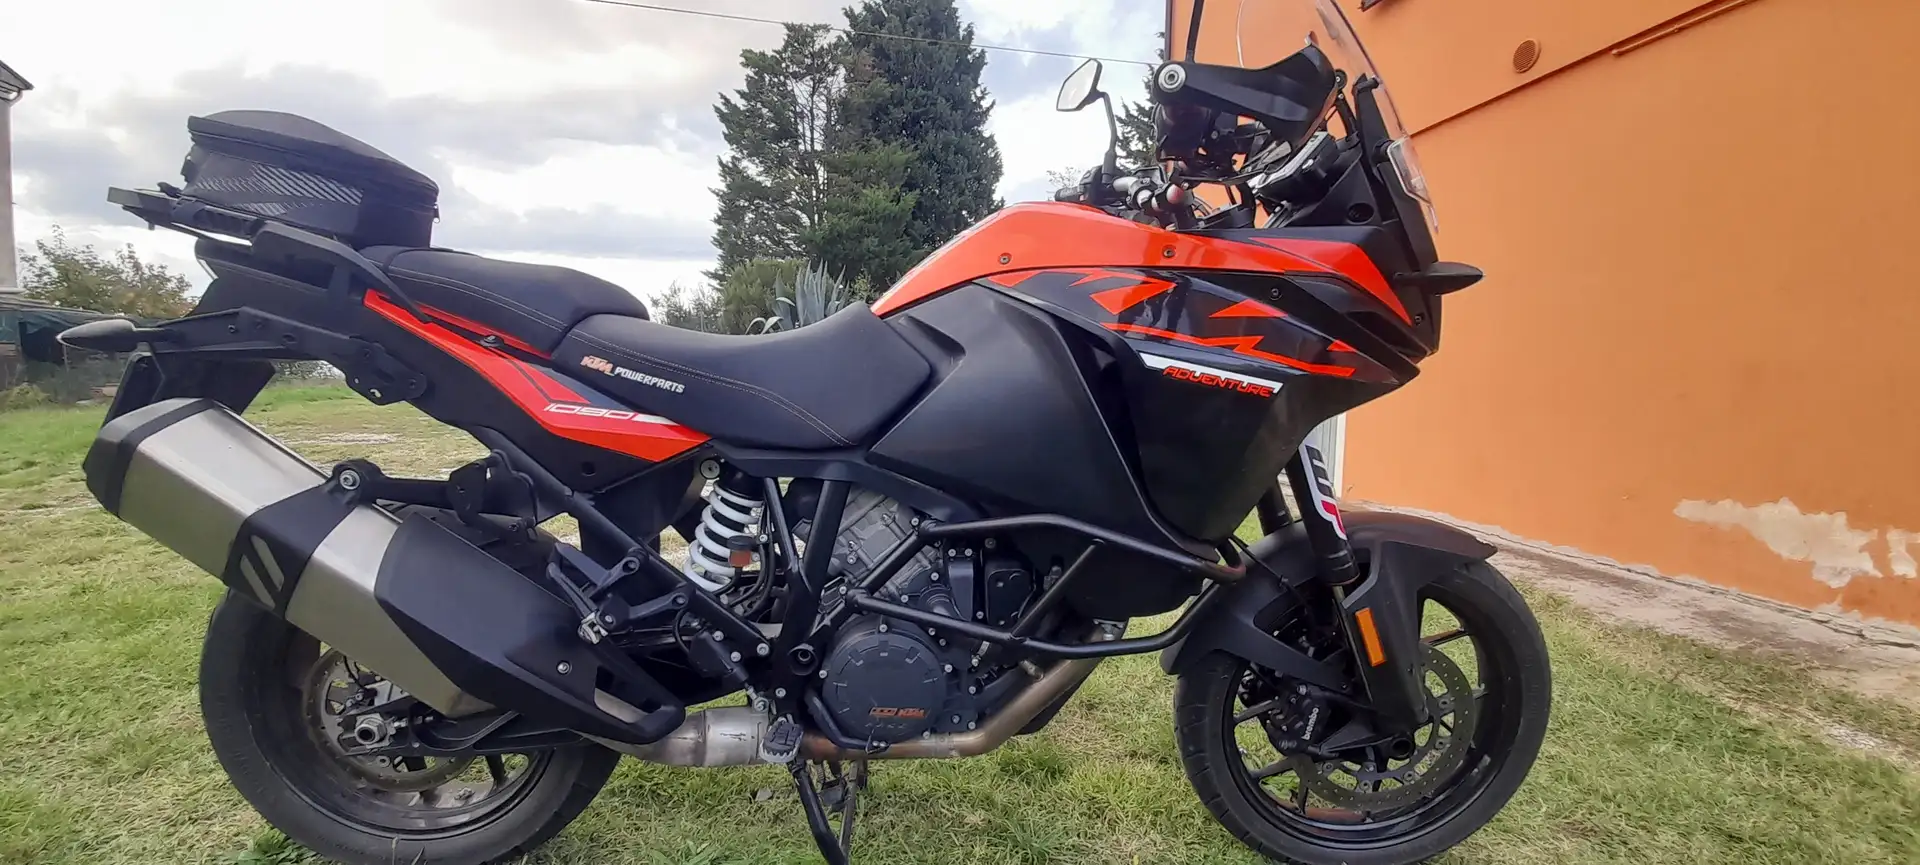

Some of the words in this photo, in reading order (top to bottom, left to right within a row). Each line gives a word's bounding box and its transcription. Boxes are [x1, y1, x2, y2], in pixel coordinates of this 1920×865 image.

[614, 366, 685, 393] POWERPARTS
[1162, 365, 1274, 397] ADVENTURE
[543, 402, 633, 420] 1090
[1301, 707, 1319, 740] brembo
